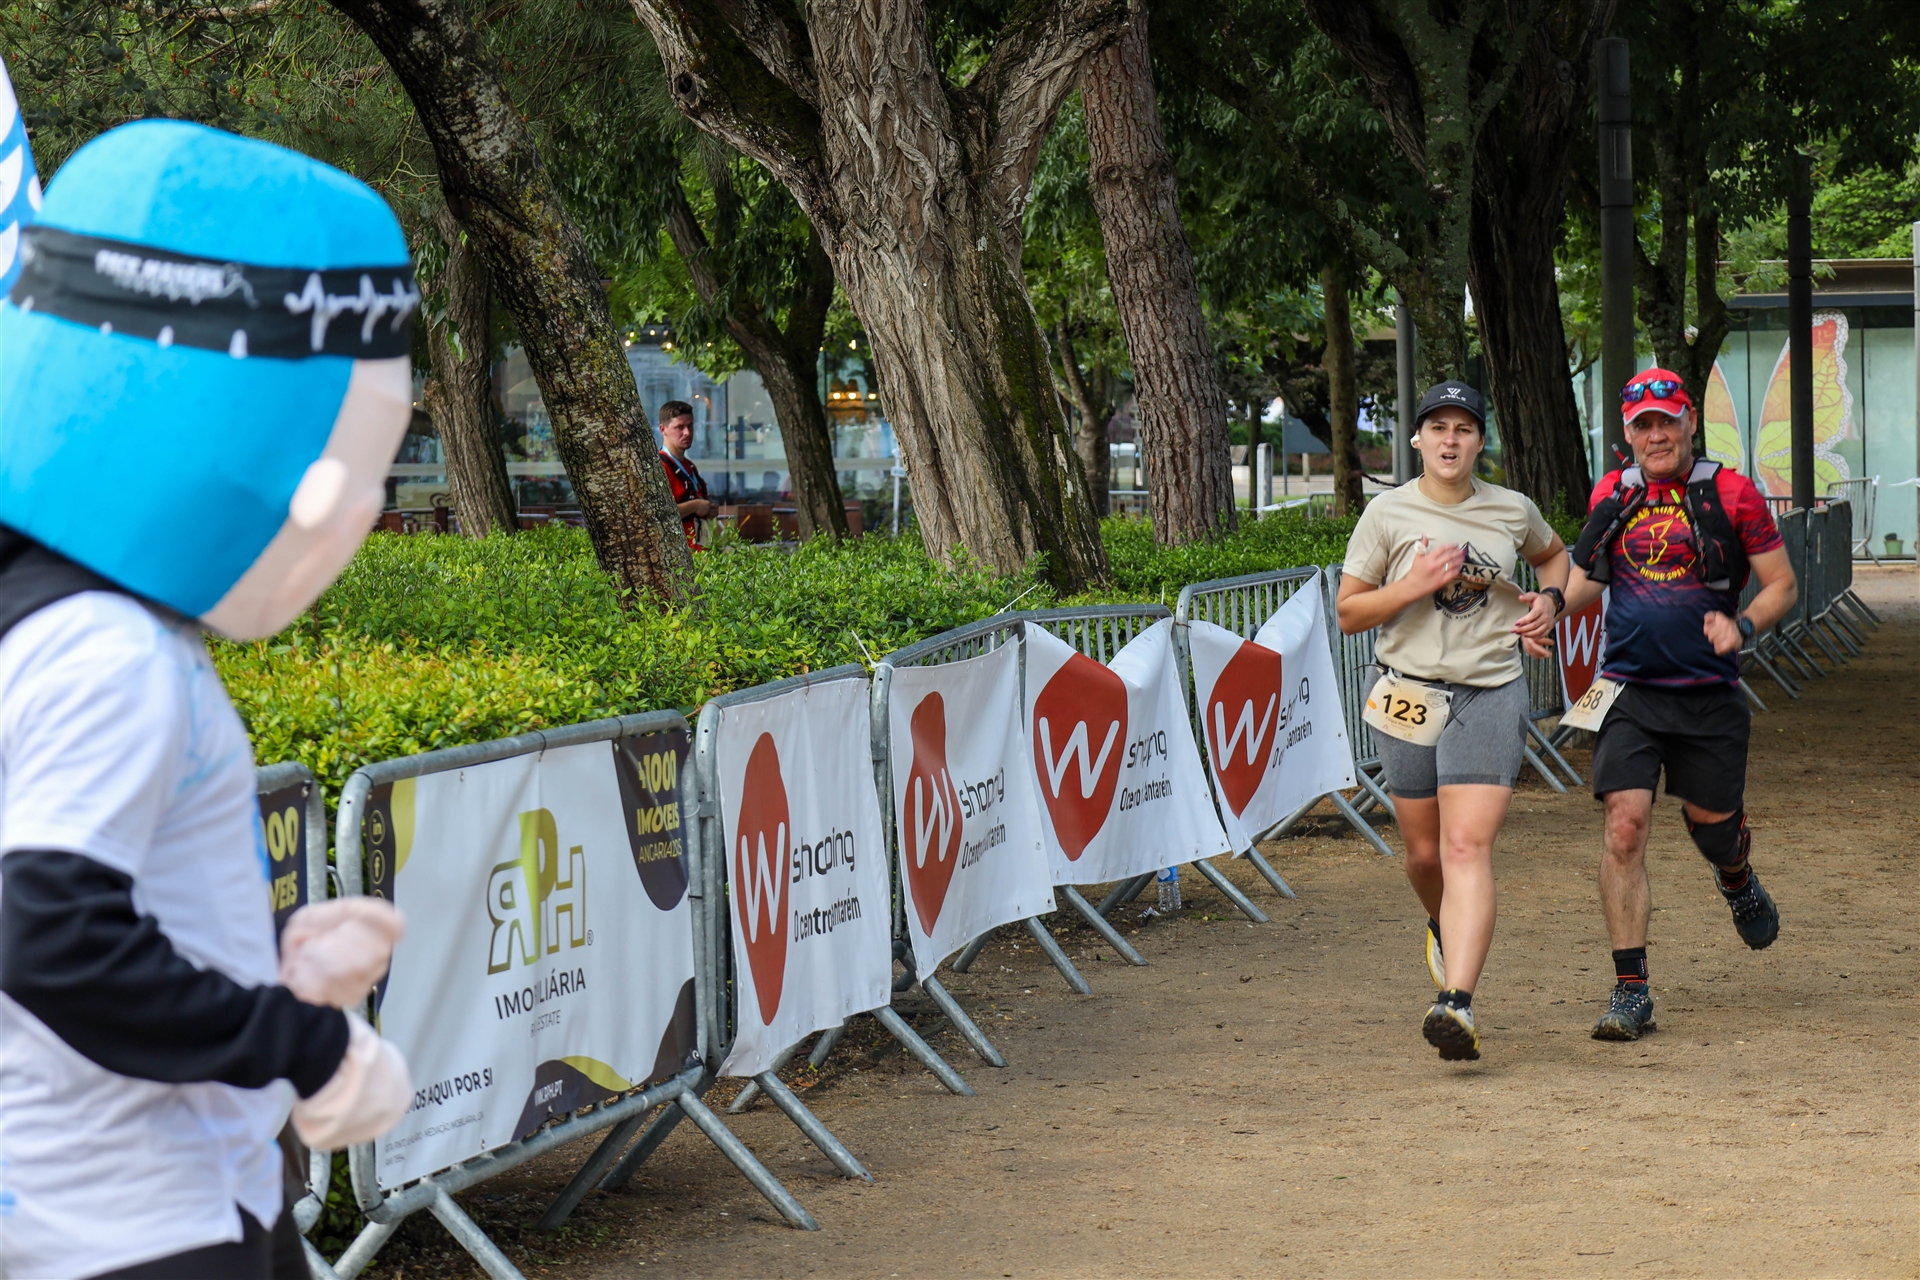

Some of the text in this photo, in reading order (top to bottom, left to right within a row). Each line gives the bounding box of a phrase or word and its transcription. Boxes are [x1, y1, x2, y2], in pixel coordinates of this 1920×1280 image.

[1460, 564, 1502, 581] AKY
[1382, 693, 1428, 726] 123
[426, 1079, 455, 1106] AQUI
[454, 1071, 482, 1096] POR
[482, 1067, 494, 1088] SI
